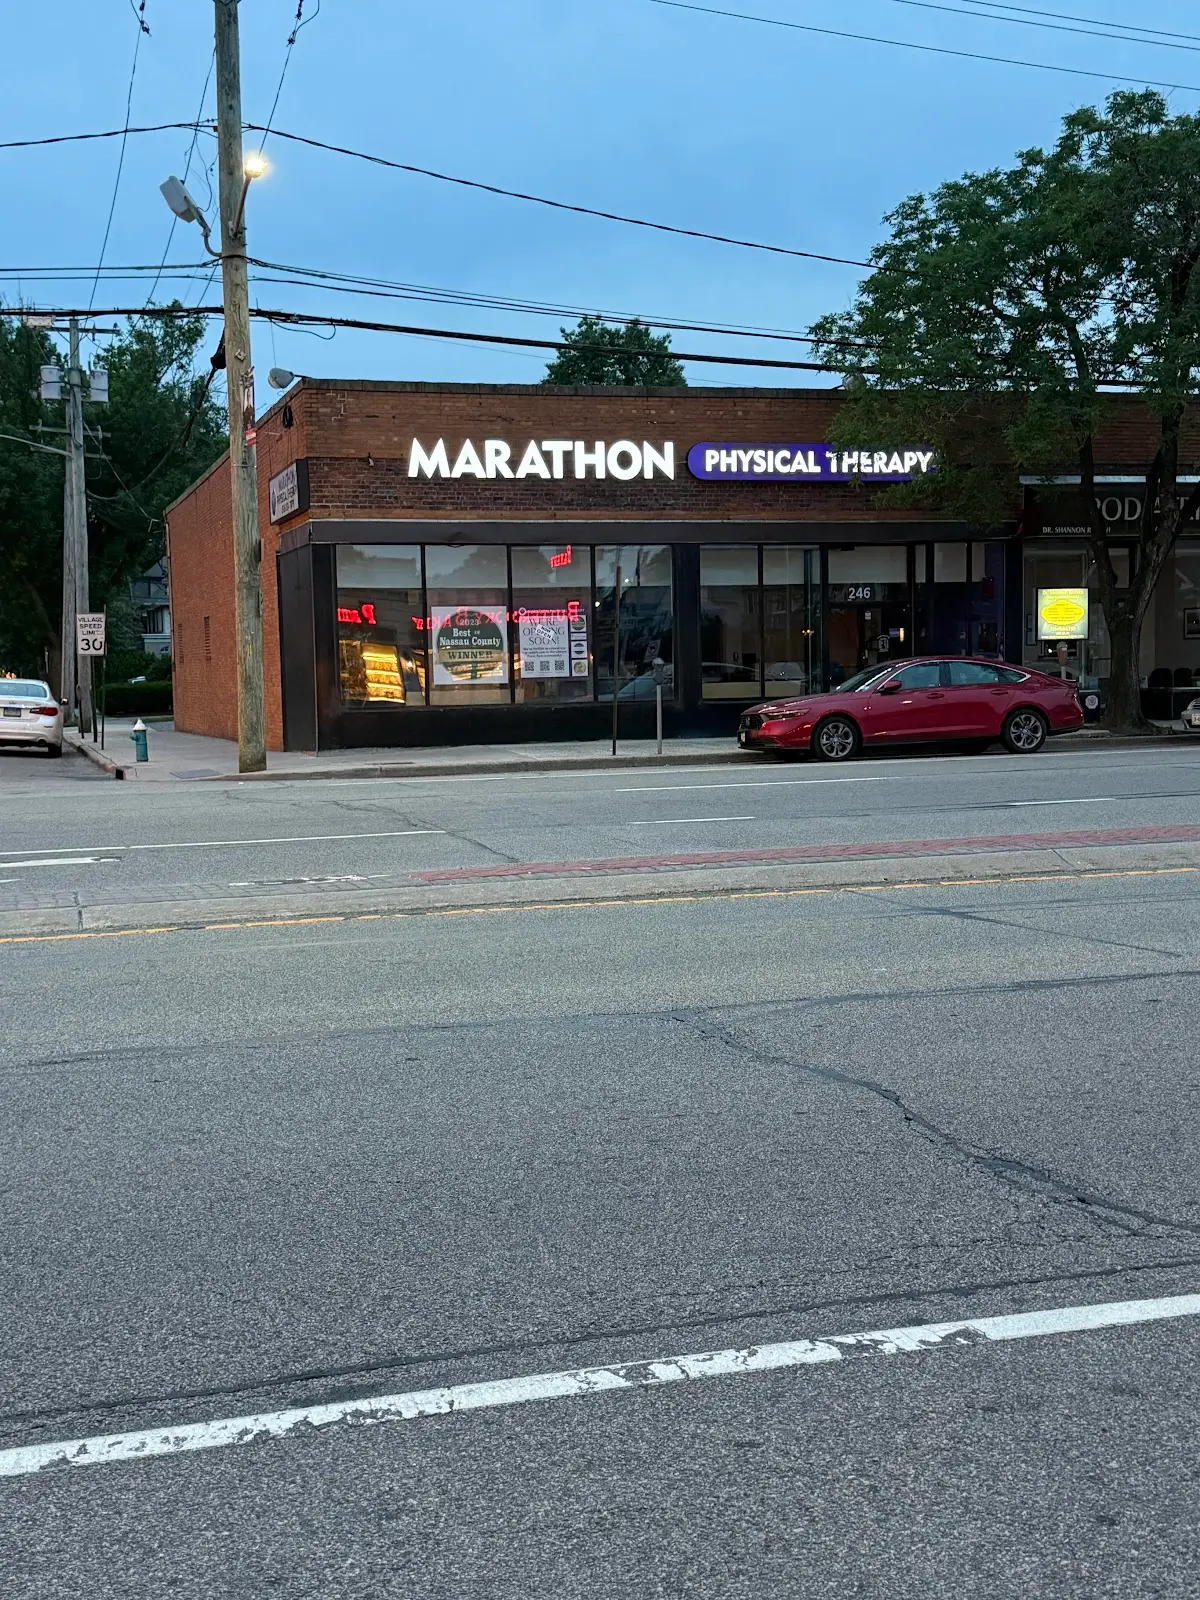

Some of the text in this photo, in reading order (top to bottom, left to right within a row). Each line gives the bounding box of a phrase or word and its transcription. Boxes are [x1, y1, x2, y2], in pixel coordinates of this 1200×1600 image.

[407, 437, 675, 481] MARATHON
[705, 449, 933, 473] PHYSICAL THERAPY
[848, 587, 871, 599] 246
[452, 628, 471, 637] Best
[536, 629, 551, 639] OPEN
[81, 638, 102, 651] 30
[439, 636, 501, 648] Nassau County
[447, 650, 494, 659] WINNER
